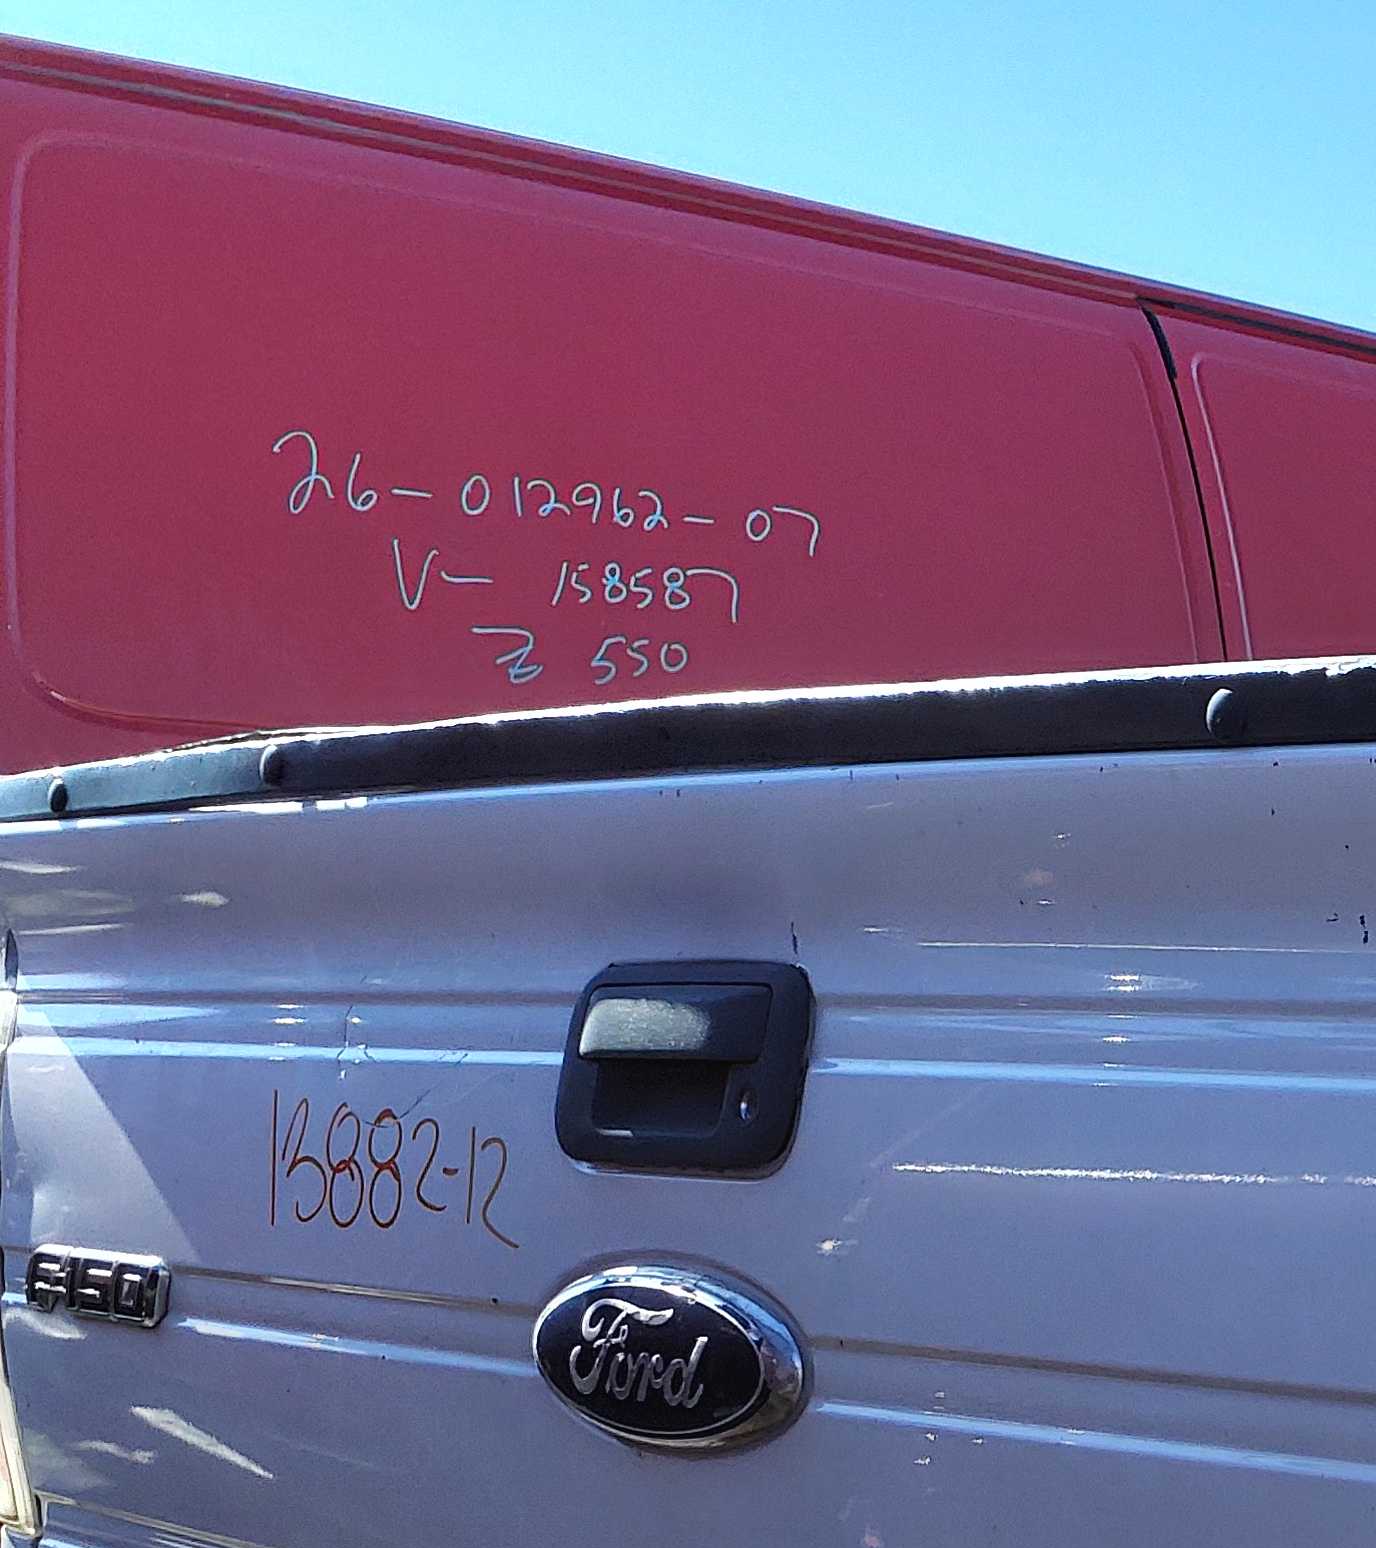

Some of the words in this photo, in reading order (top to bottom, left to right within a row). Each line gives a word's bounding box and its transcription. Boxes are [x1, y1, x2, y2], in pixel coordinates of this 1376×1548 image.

[550, 561, 740, 624] 158587
[590, 634, 689, 686] 550
[270, 1088, 521, 1250] 13882-12
[568, 1297, 710, 1409] Ford
